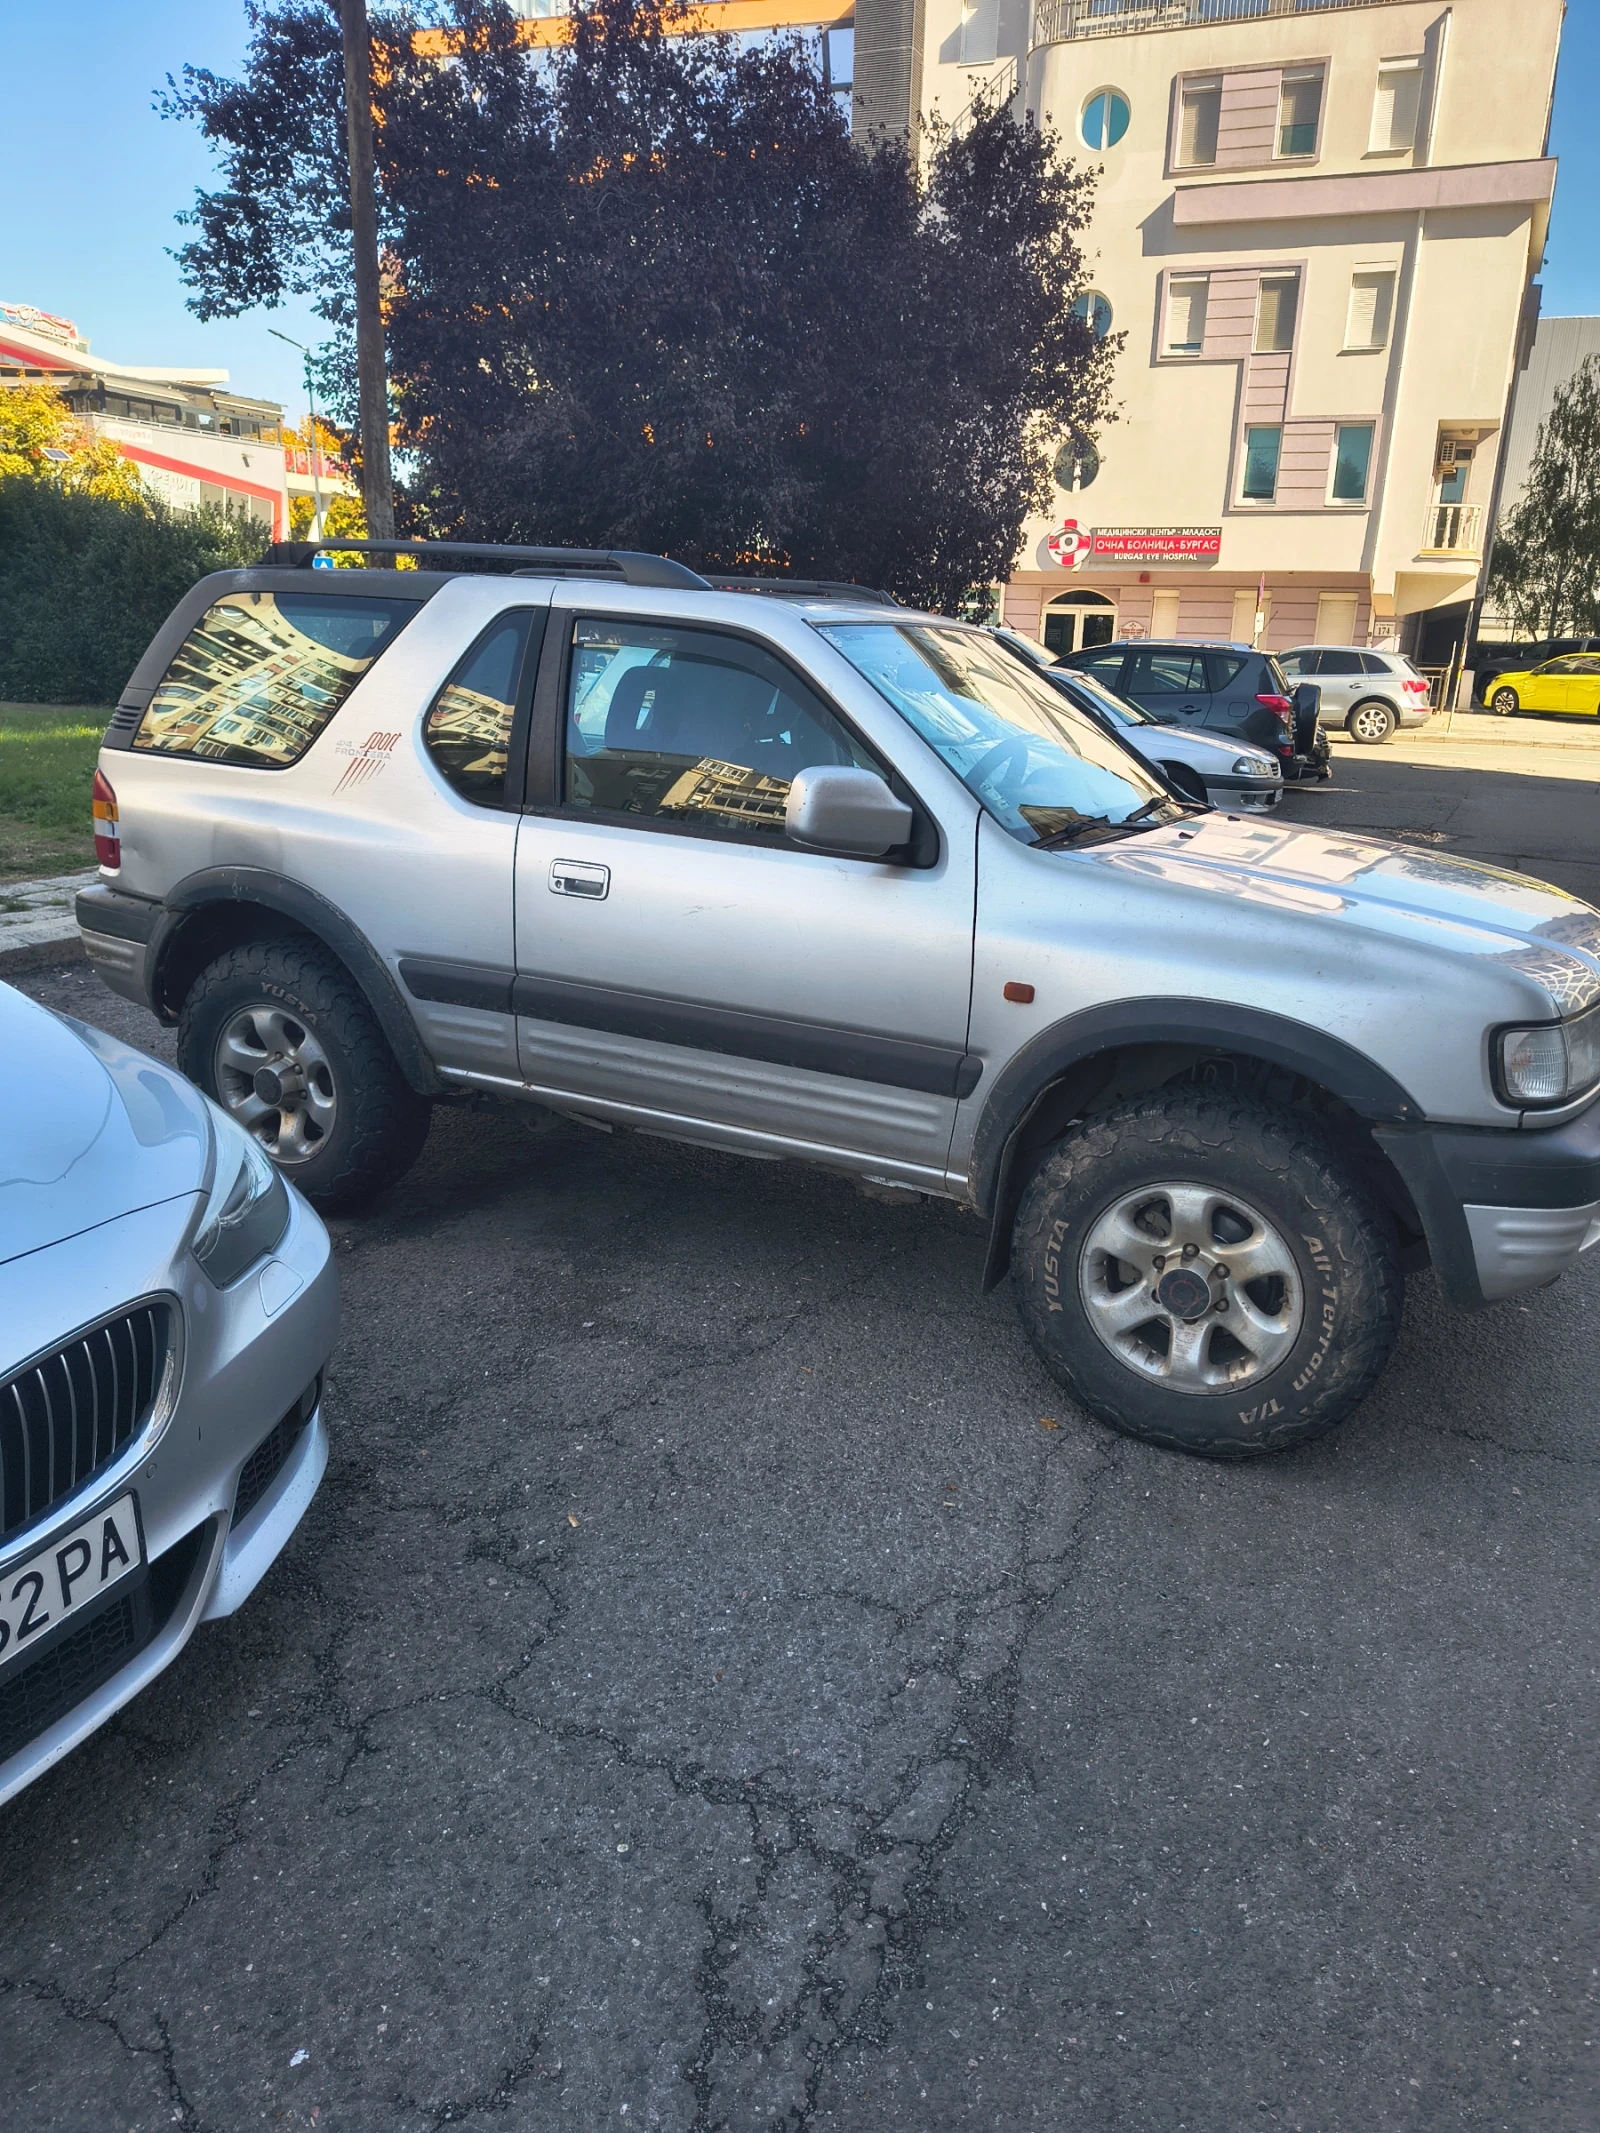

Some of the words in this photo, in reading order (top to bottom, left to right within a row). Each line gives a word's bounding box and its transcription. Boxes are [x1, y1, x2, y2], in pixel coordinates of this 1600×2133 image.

[1097, 528, 1147, 536] МЕДИЦИНСКИ
[1150, 528, 1176, 536] ЦЕНТЪР
[1182, 528, 1220, 536] МЛАДОСТ
[1096, 540, 1125, 550] ОЧНА
[1378, 627, 1390, 635] 174
[335, 747, 392, 760] FRONTERA
[260, 981, 318, 1026] YUSTA
[1043, 1218, 1071, 1312] YUSTA
[1238, 1398, 1286, 1426] T/A
